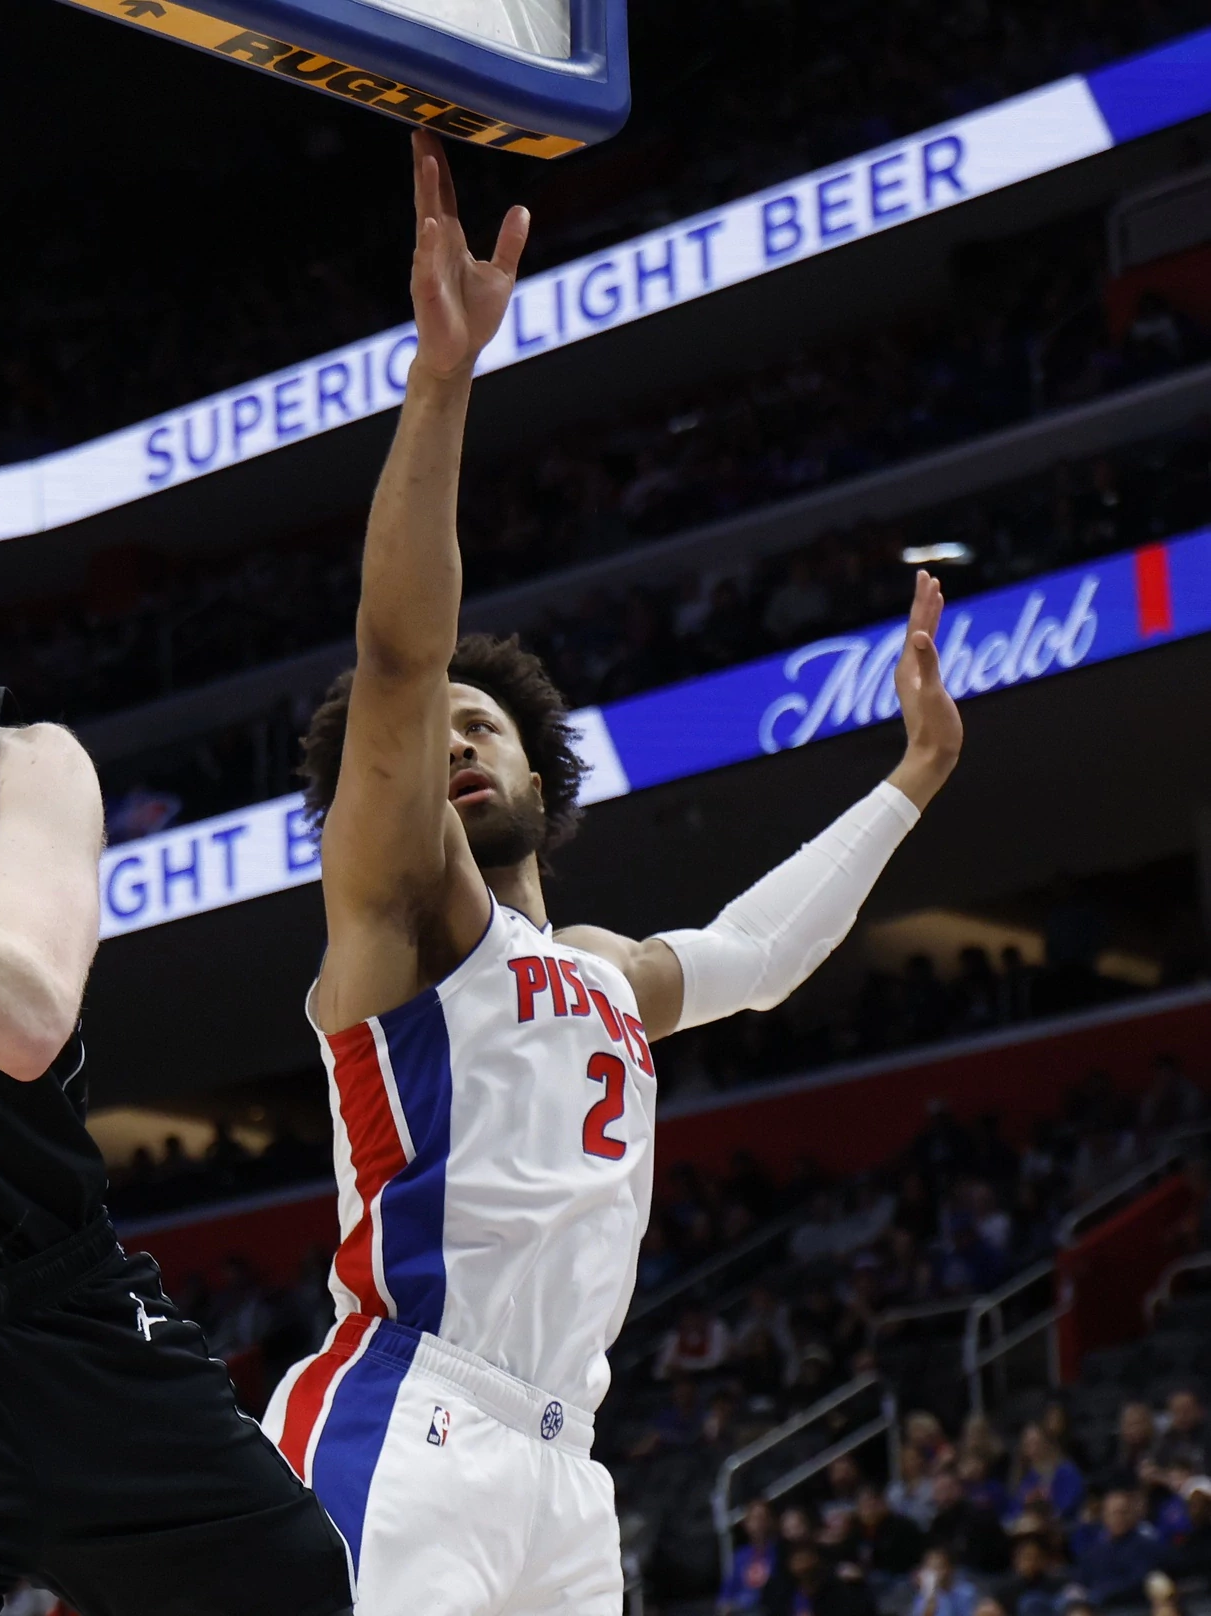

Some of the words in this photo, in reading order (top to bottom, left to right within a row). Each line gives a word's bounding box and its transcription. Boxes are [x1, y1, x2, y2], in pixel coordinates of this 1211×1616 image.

[213, 29, 548, 149] RUGIET
[146, 334, 418, 484] SUPERIO
[511, 221, 724, 350] LIGHT
[760, 134, 965, 263] BEER
[758, 575, 1100, 755] Mhelob
[106, 822, 247, 919] GHT
[582, 1051, 628, 1162] 2
